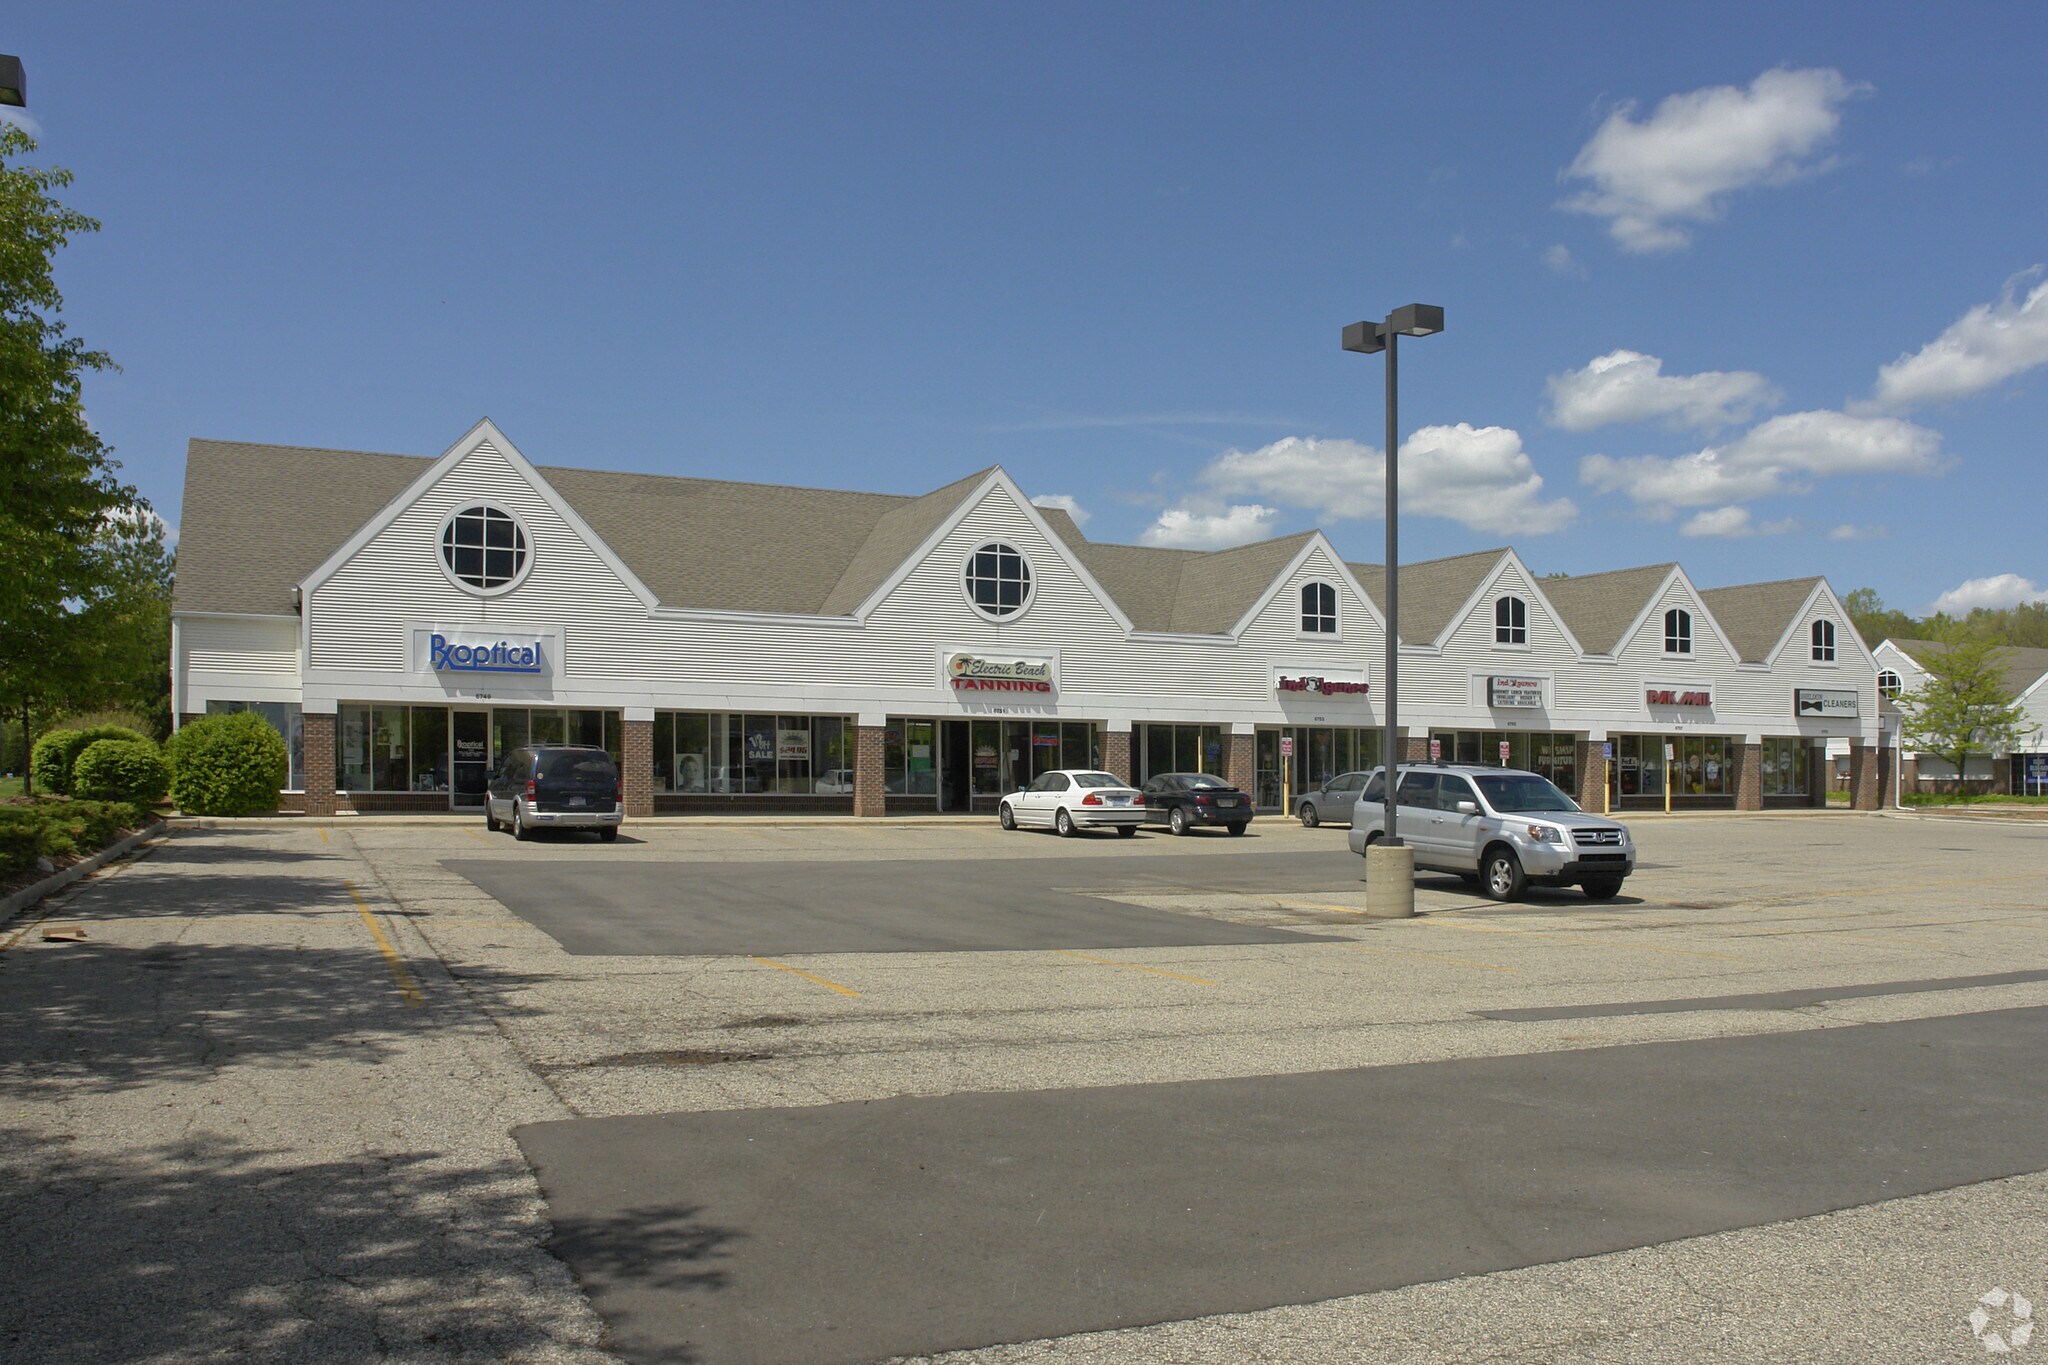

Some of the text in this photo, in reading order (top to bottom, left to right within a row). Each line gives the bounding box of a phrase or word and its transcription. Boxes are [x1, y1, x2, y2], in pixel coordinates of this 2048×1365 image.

[971, 660, 1046, 676] Electric Beach
[951, 679, 1051, 692] TANNING
[1646, 689, 1712, 706] PAK MAIL
[1823, 700, 1856, 708] CLEANERS
[749, 751, 773, 759] SALE
[1555, 745, 1575, 755] SHIP
